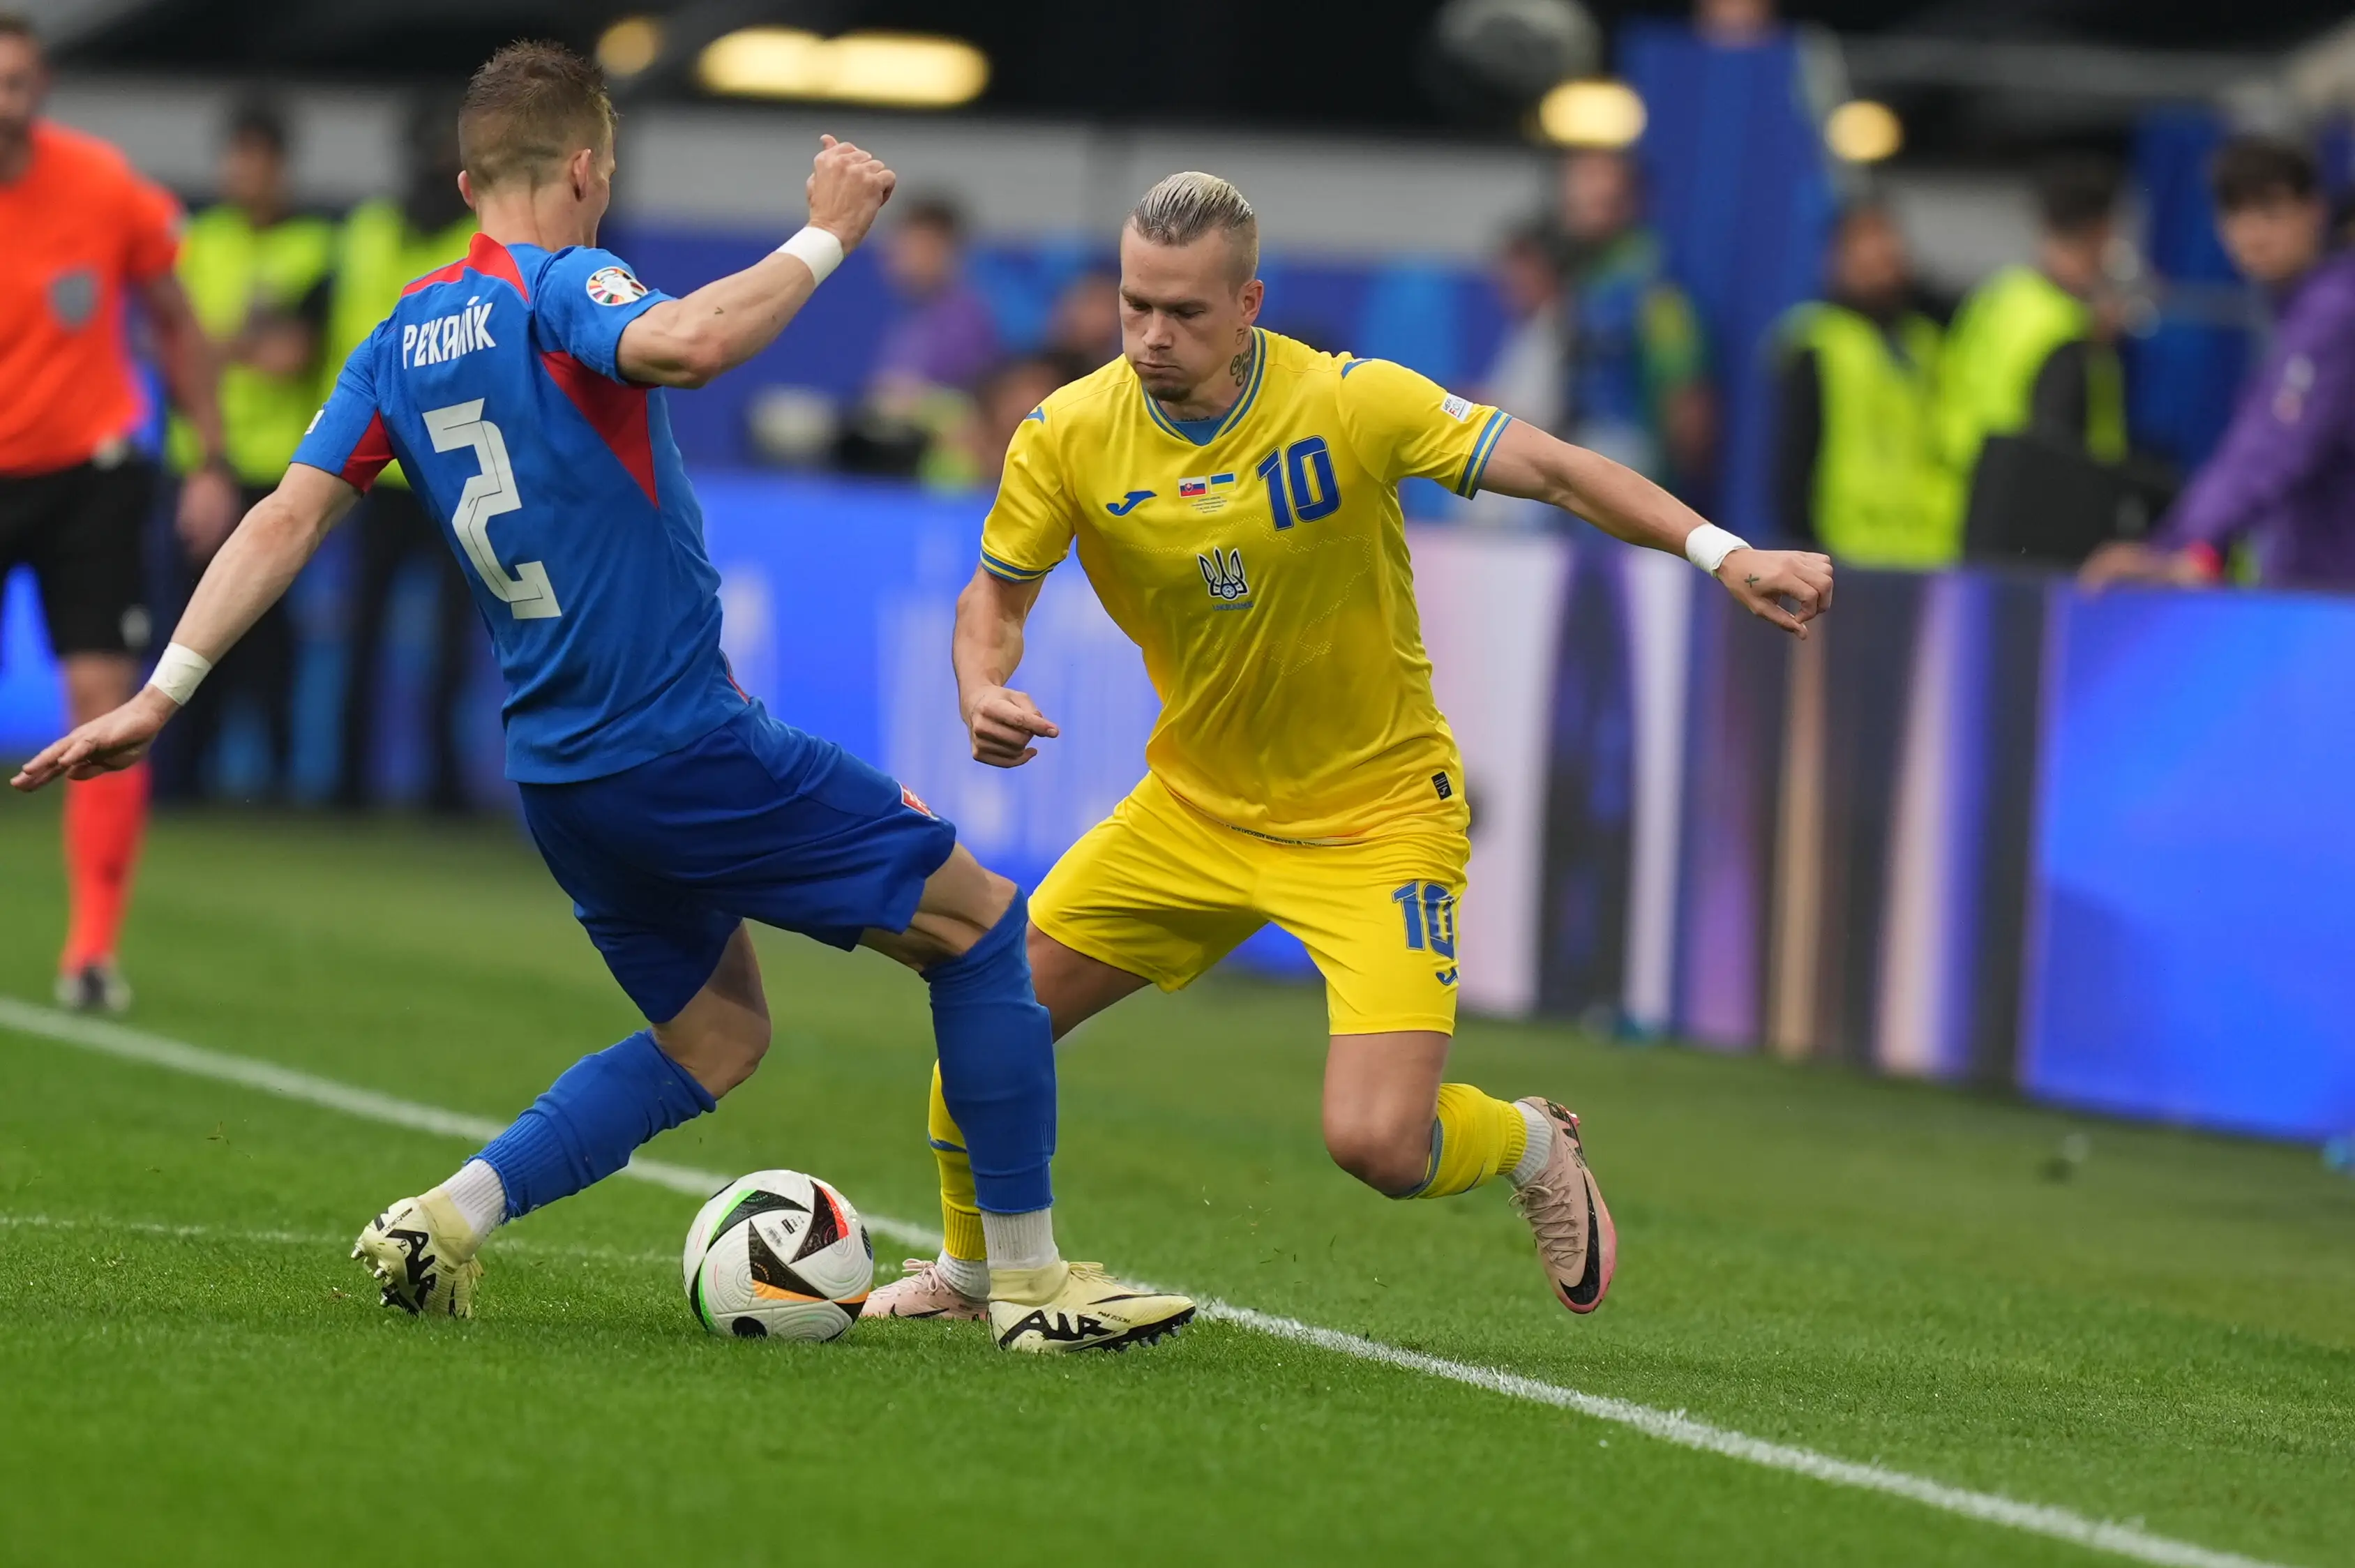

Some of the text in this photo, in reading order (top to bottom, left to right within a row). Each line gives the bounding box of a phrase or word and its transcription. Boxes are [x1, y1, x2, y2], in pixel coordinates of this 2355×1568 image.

[422, 397, 562, 619] 2
[1256, 435, 1342, 532] 10
[1391, 880, 1456, 961] 10
